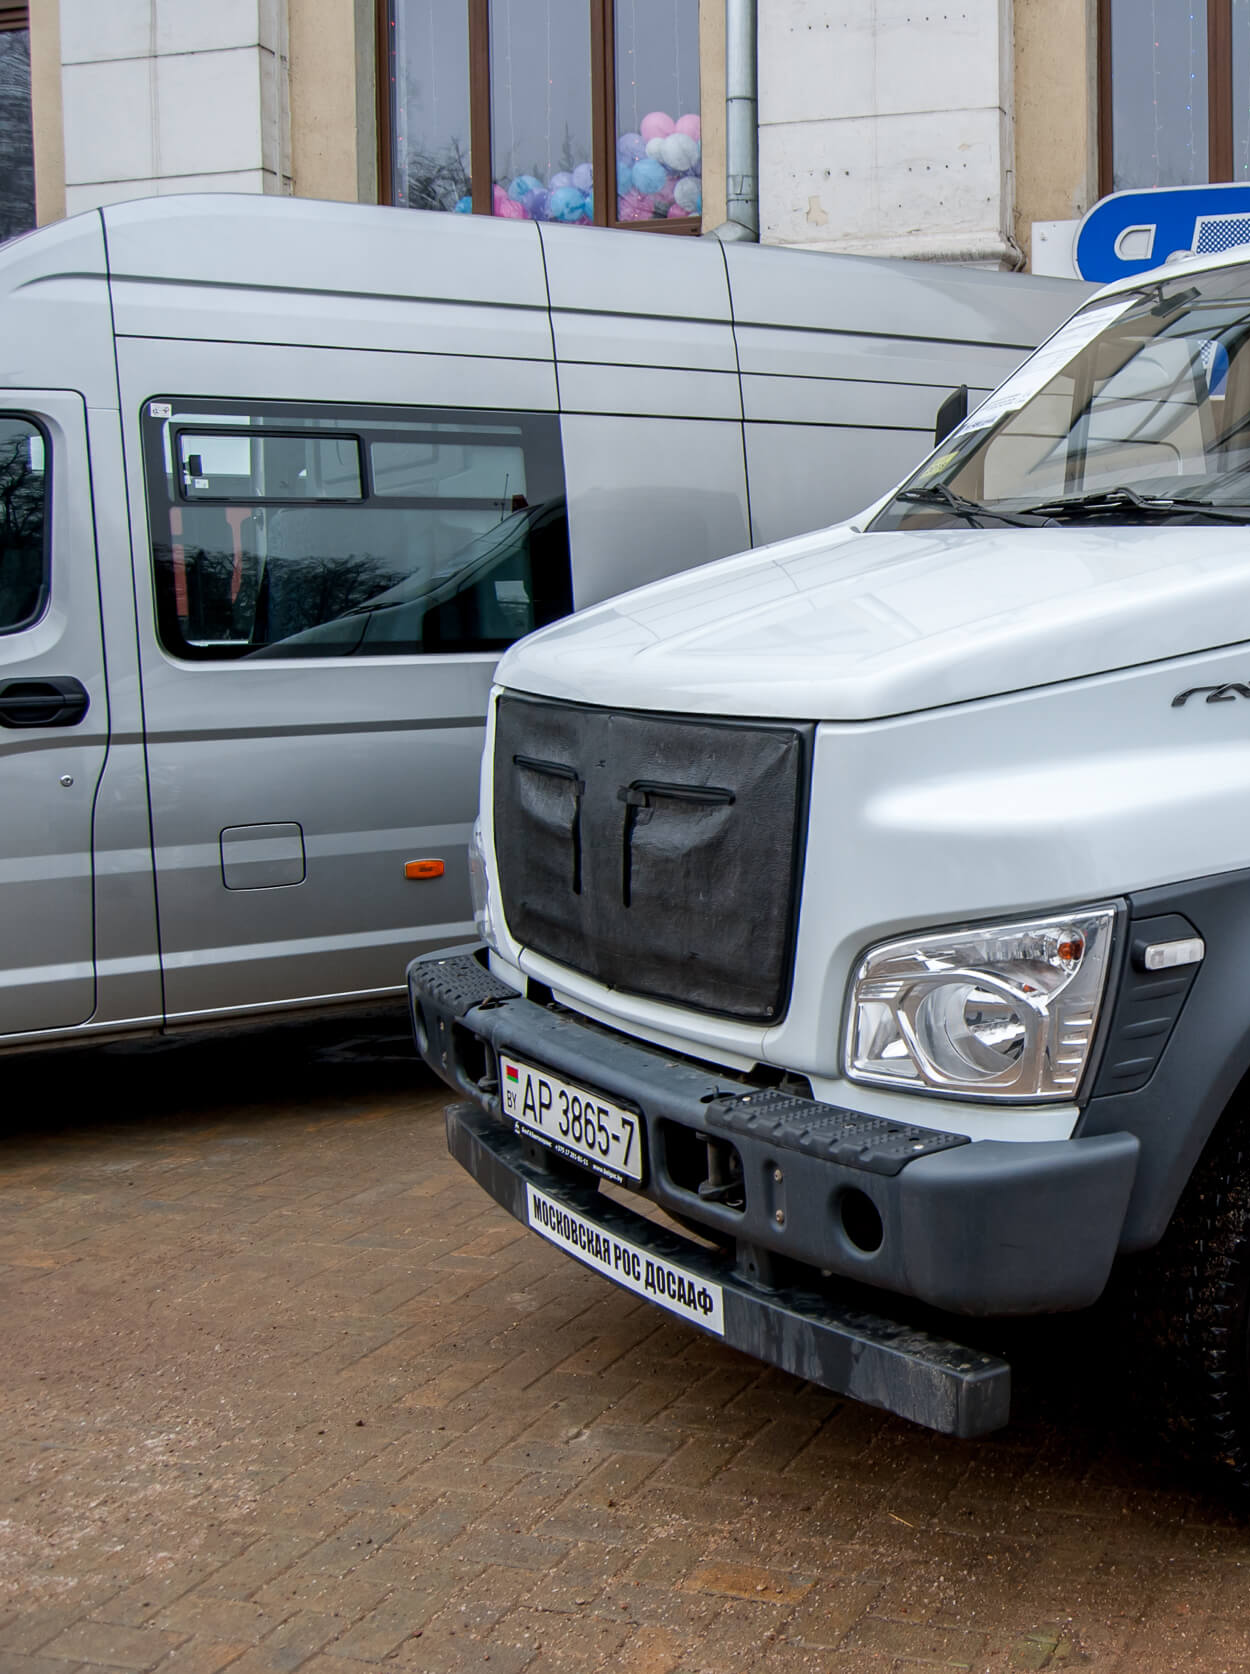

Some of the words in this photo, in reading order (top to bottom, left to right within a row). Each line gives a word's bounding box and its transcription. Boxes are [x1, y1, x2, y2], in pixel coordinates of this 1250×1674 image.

[506, 1089, 517, 1111] BY
[522, 1073, 553, 1125] AP
[558, 1089, 635, 1167] 3865-7
[533, 1194, 611, 1266] МОСКОВСКАЯ
[613, 1242, 641, 1281] РОС
[645, 1259, 714, 1316] ДОСААФ
